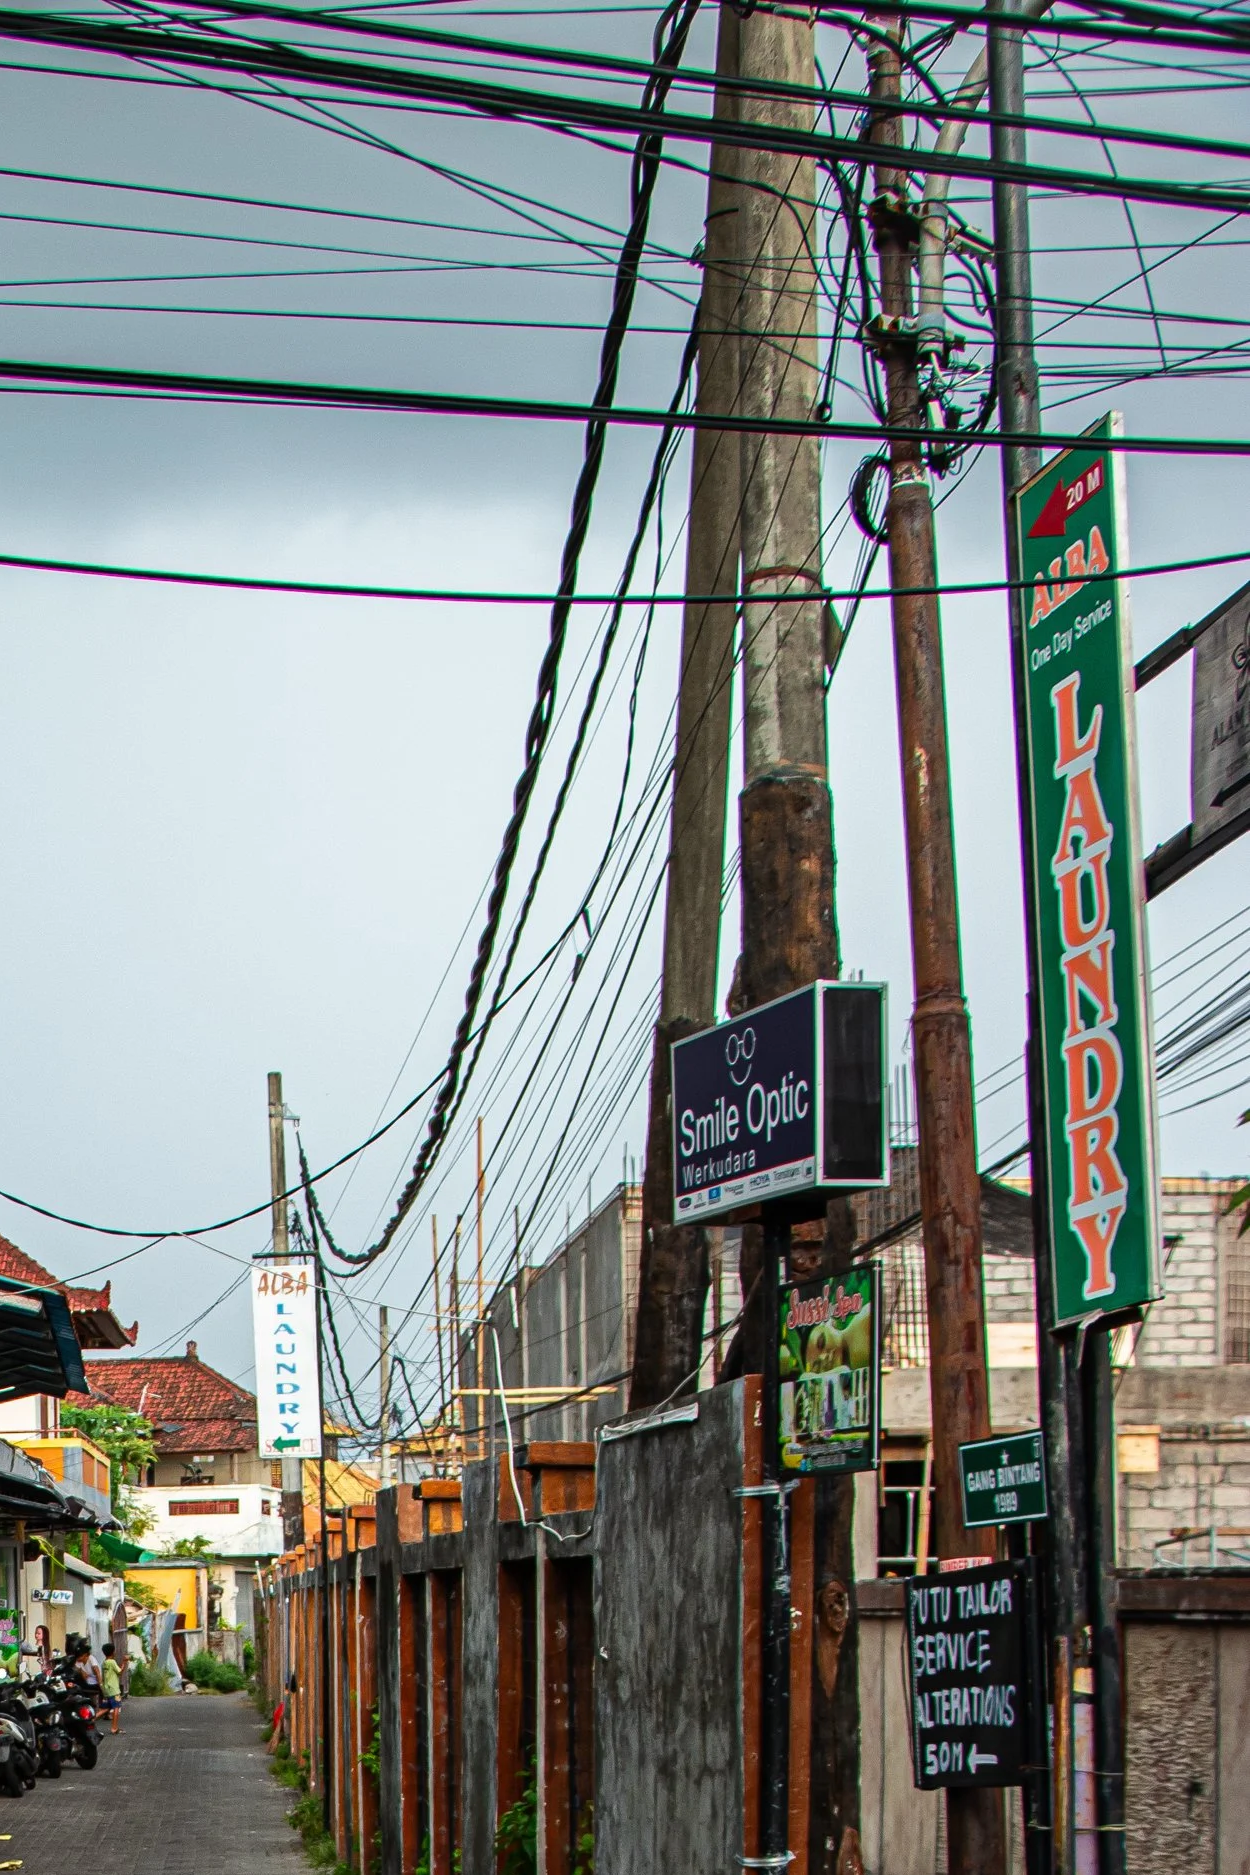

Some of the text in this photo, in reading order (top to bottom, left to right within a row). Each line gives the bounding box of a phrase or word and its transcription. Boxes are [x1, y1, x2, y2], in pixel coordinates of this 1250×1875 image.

[1066, 467, 1100, 511] 20 M
[1029, 525, 1111, 629] ALBA
[1031, 599, 1113, 671] One Day Service
[1049, 670, 1129, 1300] LAUNDRY
[680, 1071, 809, 1157] Smile Optic
[682, 1149, 756, 1188] Werkudara
[258, 1271, 307, 1297] ALBA
[274, 1304, 300, 1434] LAUNDRY
[966, 1461, 1041, 1492] GANG BINTANG
[955, 1579, 1012, 1619] TAILOR
[915, 1629, 991, 1677] SERVICE
[916, 1685, 1016, 1728] ALTERATIONS
